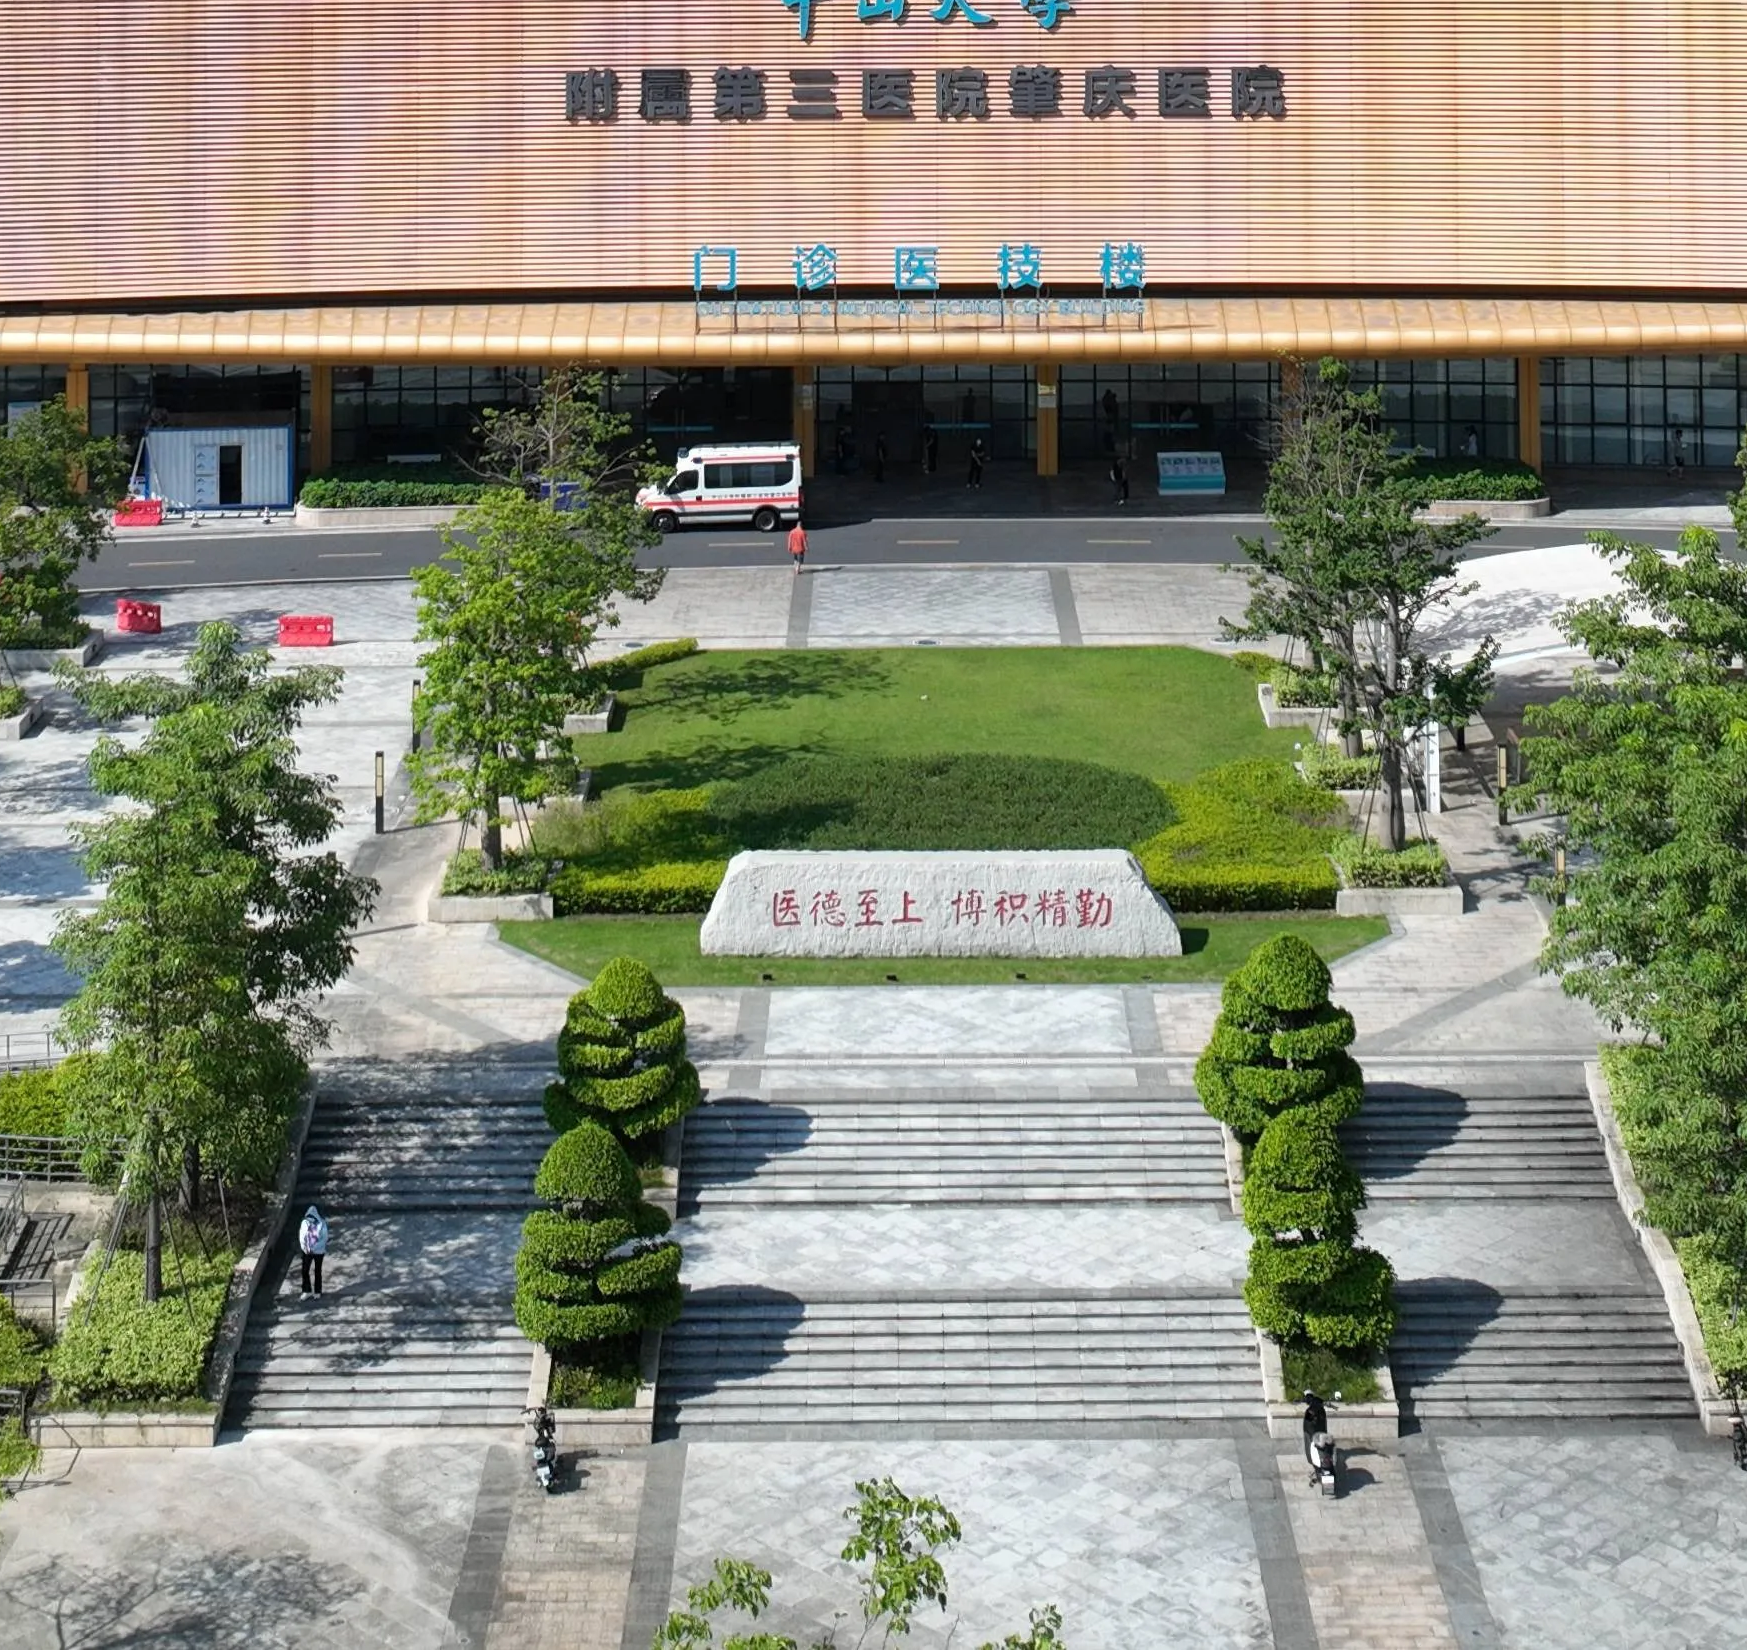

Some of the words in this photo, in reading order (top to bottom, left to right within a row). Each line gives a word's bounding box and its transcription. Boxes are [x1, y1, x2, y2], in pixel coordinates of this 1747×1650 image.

[565, 65, 1286, 122] 附属第三医院肇庆医院
[694, 242, 1146, 292] 门诊医技楼
[698, 301, 815, 317] OUTPATIENT
[820, 301, 831, 316] &
[1059, 300, 1145, 316] BUILDING
[772, 888, 924, 928] 医德至上
